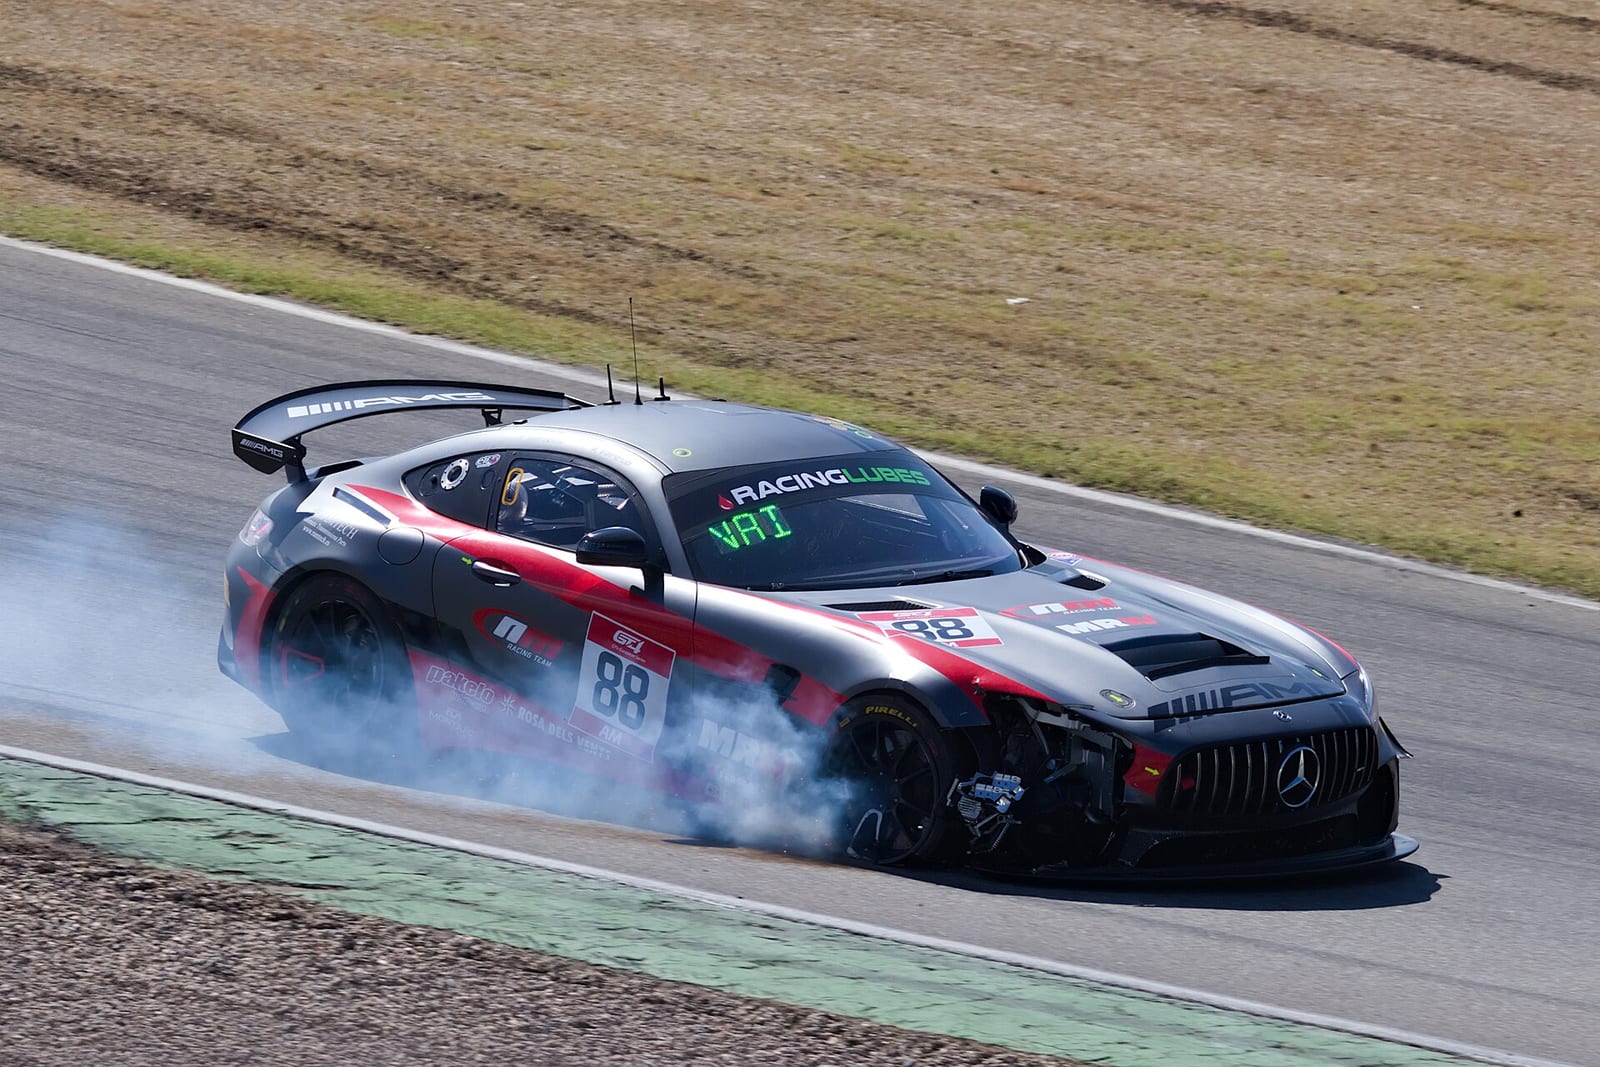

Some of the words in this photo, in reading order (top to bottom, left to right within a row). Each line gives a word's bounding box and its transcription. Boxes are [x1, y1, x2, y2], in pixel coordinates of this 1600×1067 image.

[354, 391, 496, 409] AMG
[253, 442, 284, 458] AMG
[729, 467, 931, 506] RACINGLUBES
[708, 504, 792, 549] VAI
[612, 629, 645, 655] GT4
[891, 618, 974, 641] 88
[506, 643, 532, 659] RACING
[533, 654, 552, 667] TEAM
[425, 664, 495, 705] pakelo
[592, 650, 650, 731] 88
[517, 705, 546, 731] ROSA
[548, 721, 574, 744] DELS
[865, 705, 918, 728] PIRELLI
[598, 724, 624, 746] AM
